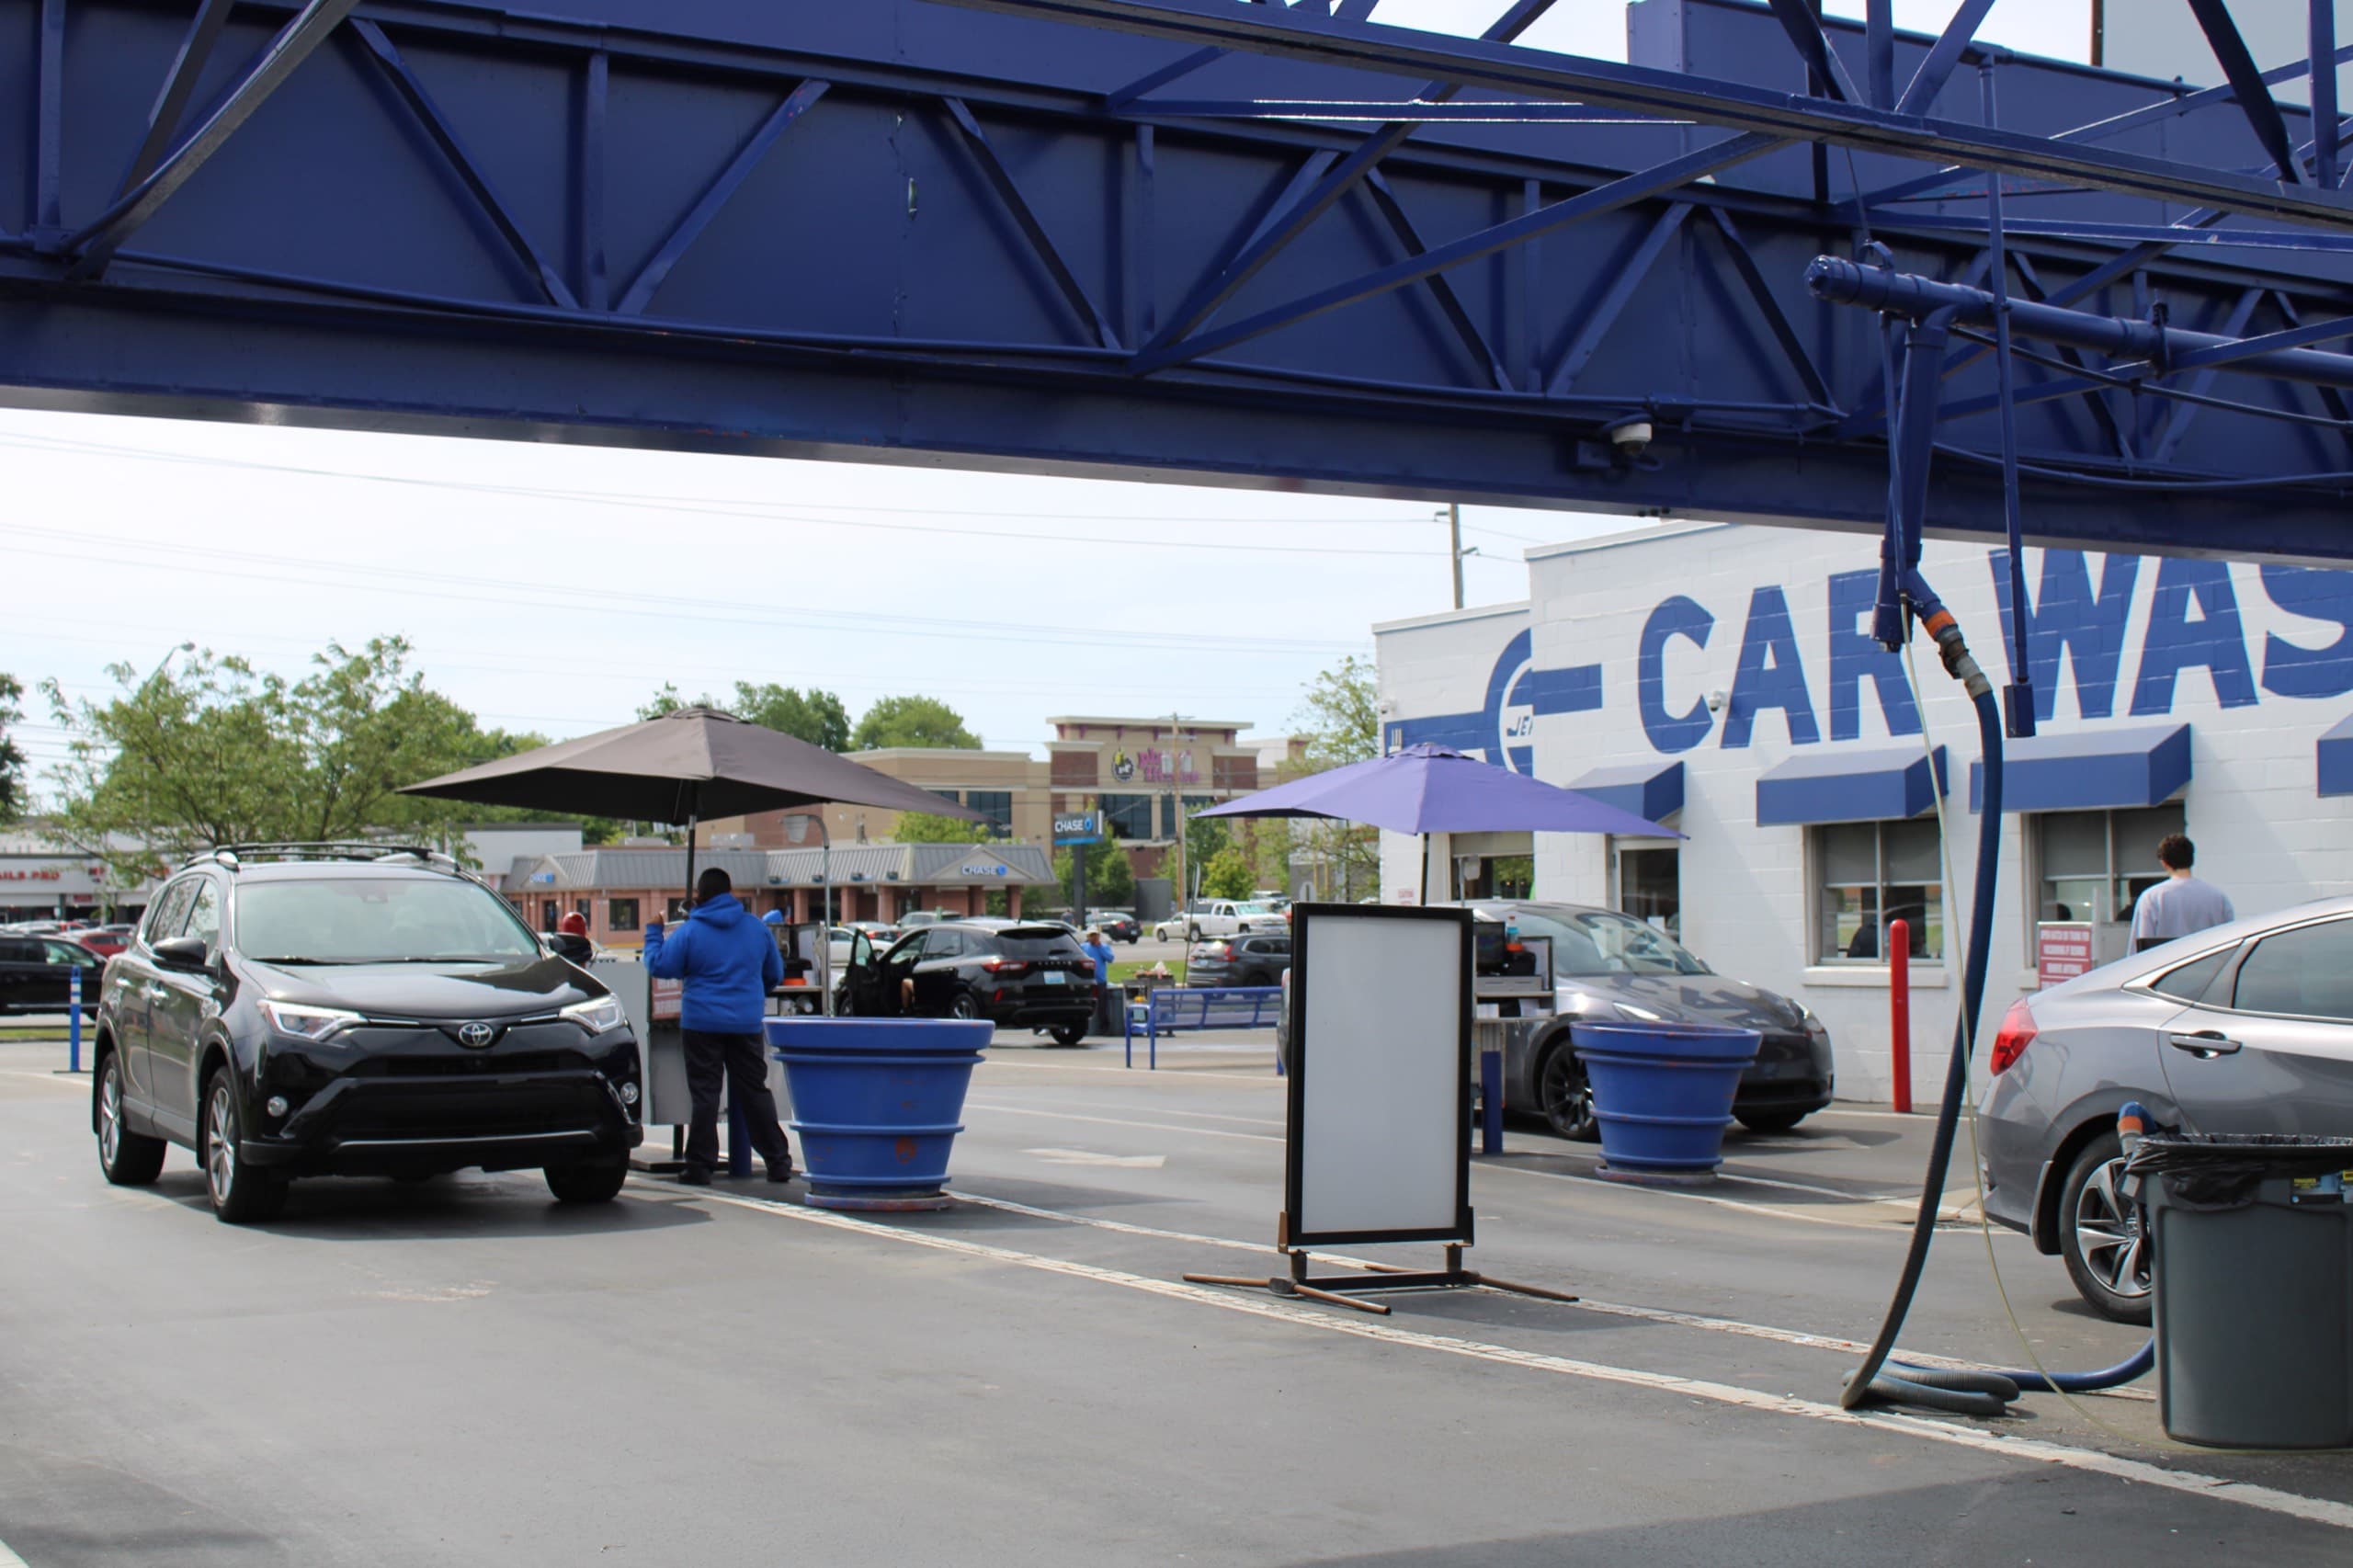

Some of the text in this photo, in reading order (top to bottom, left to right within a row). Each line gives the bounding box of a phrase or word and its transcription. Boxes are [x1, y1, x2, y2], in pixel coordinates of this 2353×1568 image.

[1638, 567, 1927, 754] CAR
[1506, 715, 1534, 737] JE
[1054, 818, 1084, 833] CHASE
[961, 865, 997, 876] CHASE
